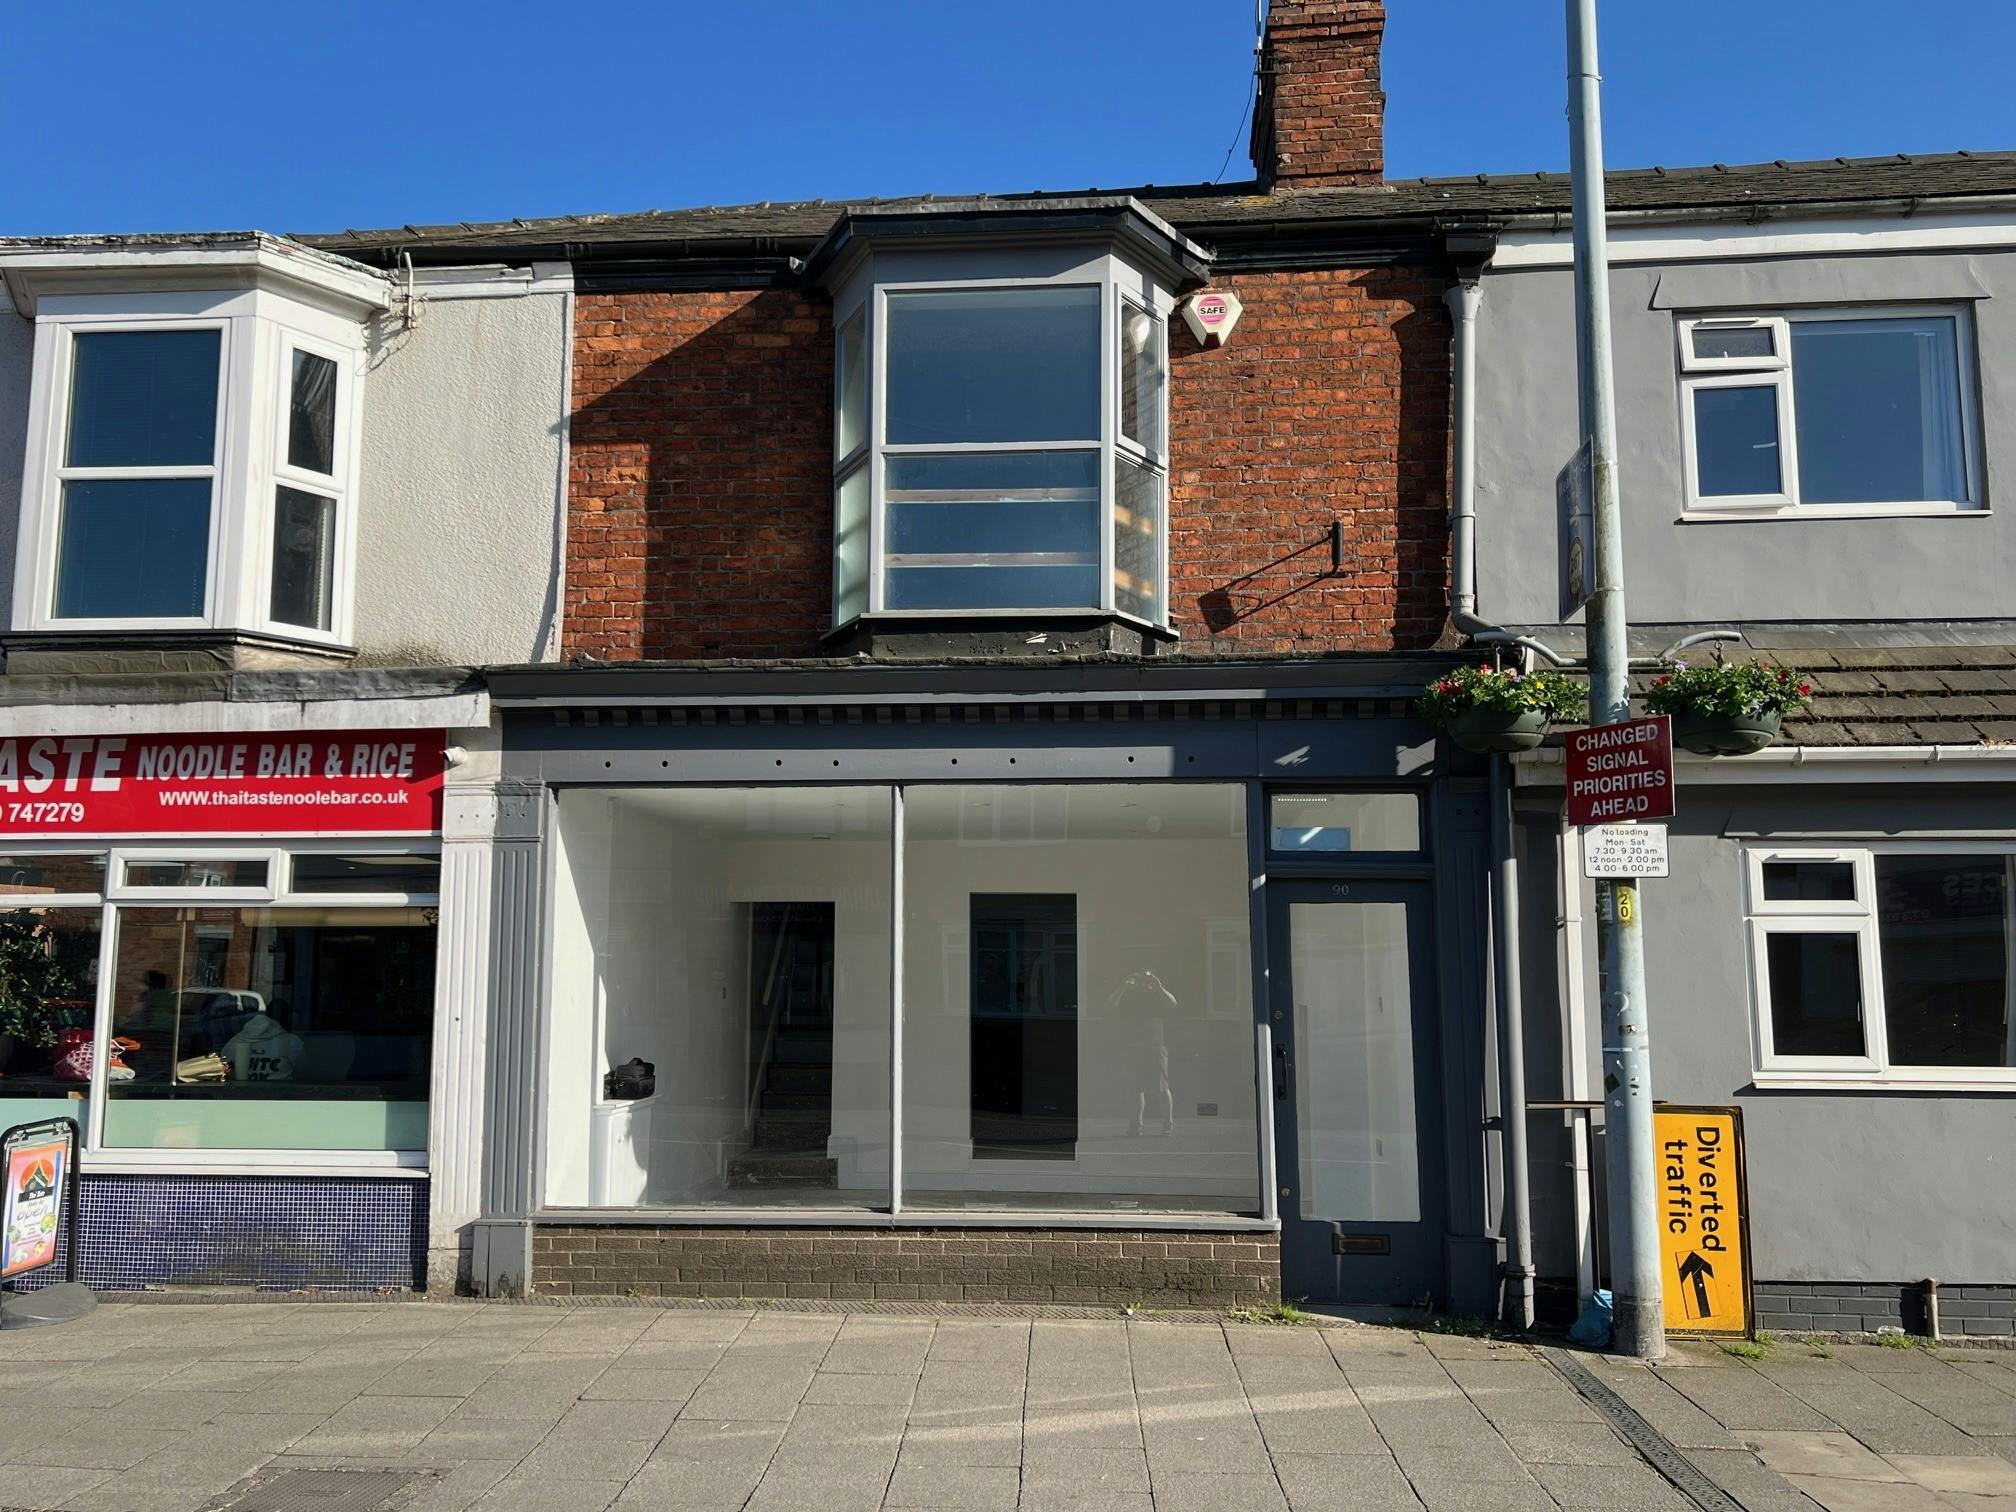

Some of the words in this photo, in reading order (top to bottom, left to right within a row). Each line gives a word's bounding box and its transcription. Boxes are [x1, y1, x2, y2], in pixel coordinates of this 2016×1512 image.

[1200, 306, 1225, 315] SAFE
[1575, 723, 1659, 752] CHANGED
[0, 737, 128, 794] ASTE
[136, 744, 248, 781] NOODLE
[256, 743, 313, 779] BAR
[324, 743, 343, 779] &
[350, 743, 416, 779] RICE
[1586, 749, 1649, 772] SIGNAL
[1573, 769, 1666, 797] PRIORITIES
[8, 802, 85, 823] 747279
[1590, 795, 1649, 817] AHEAD
[1601, 828, 1615, 836] No
[1616, 828, 1649, 837] loading
[1605, 838, 1625, 846] Mon
[1630, 838, 1646, 846] Sat
[1646, 865, 1660, 873] pm
[1332, 884, 1349, 896] 90
[1664, 1138, 1693, 1235] traffic
[1695, 1126, 1727, 1252] Diverted
